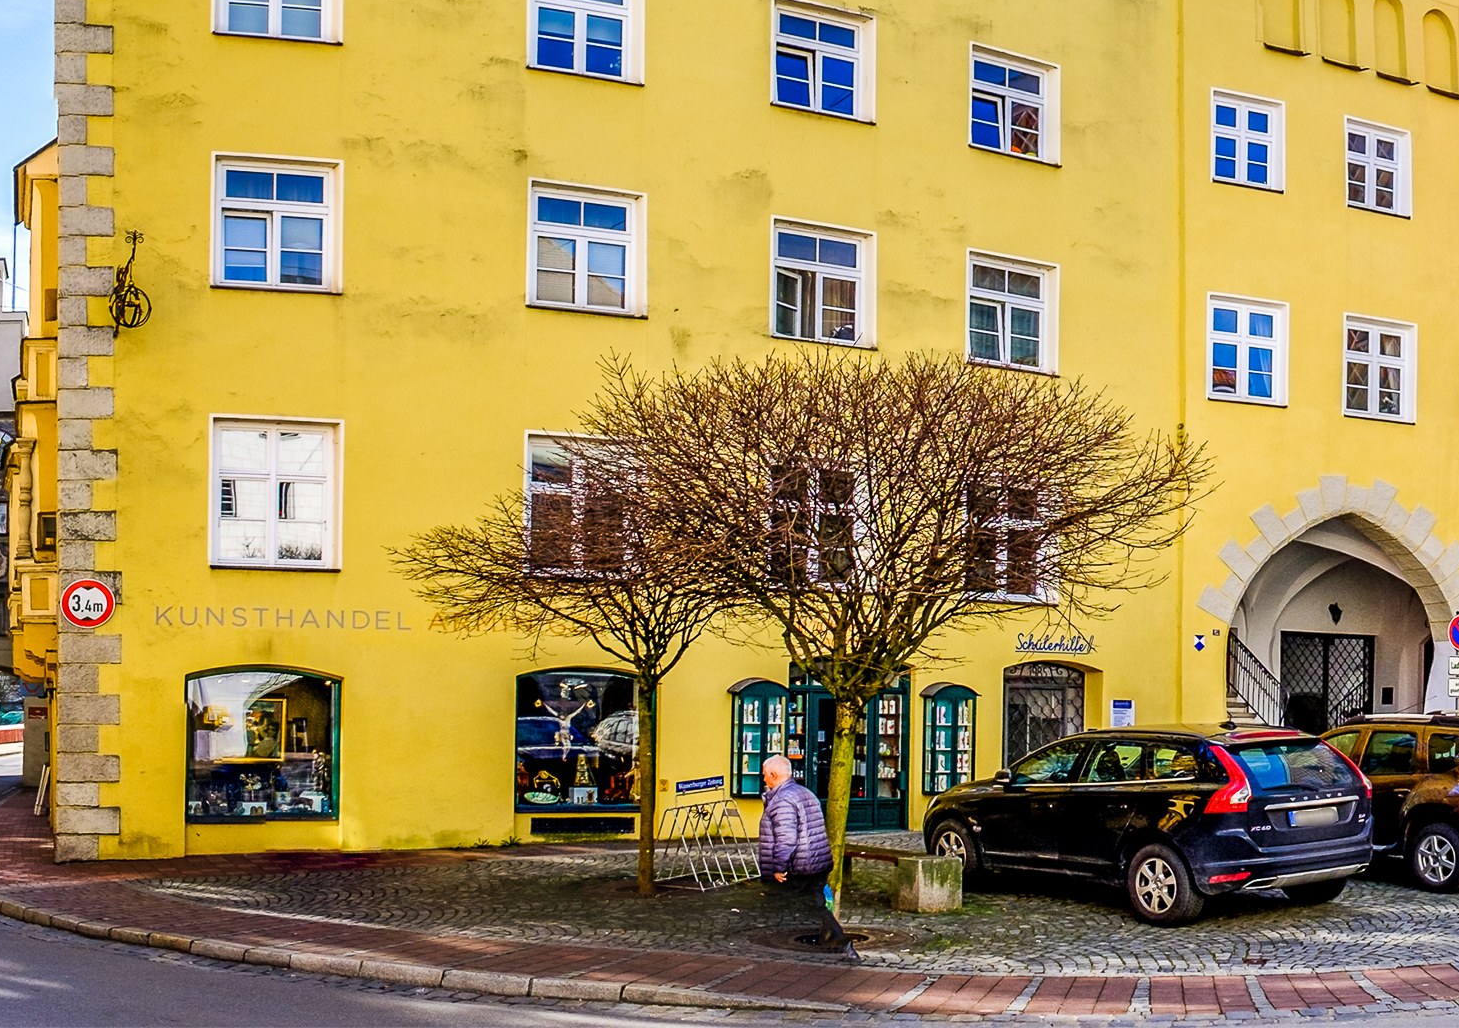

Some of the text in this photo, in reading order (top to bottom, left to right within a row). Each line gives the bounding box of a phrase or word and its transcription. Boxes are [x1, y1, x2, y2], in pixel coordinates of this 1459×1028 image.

[155, 605, 412, 631] KUNSTHANDEL
[678, 780, 707, 790] Wasserburger
[1289, 792, 1343, 802] VOLVO
